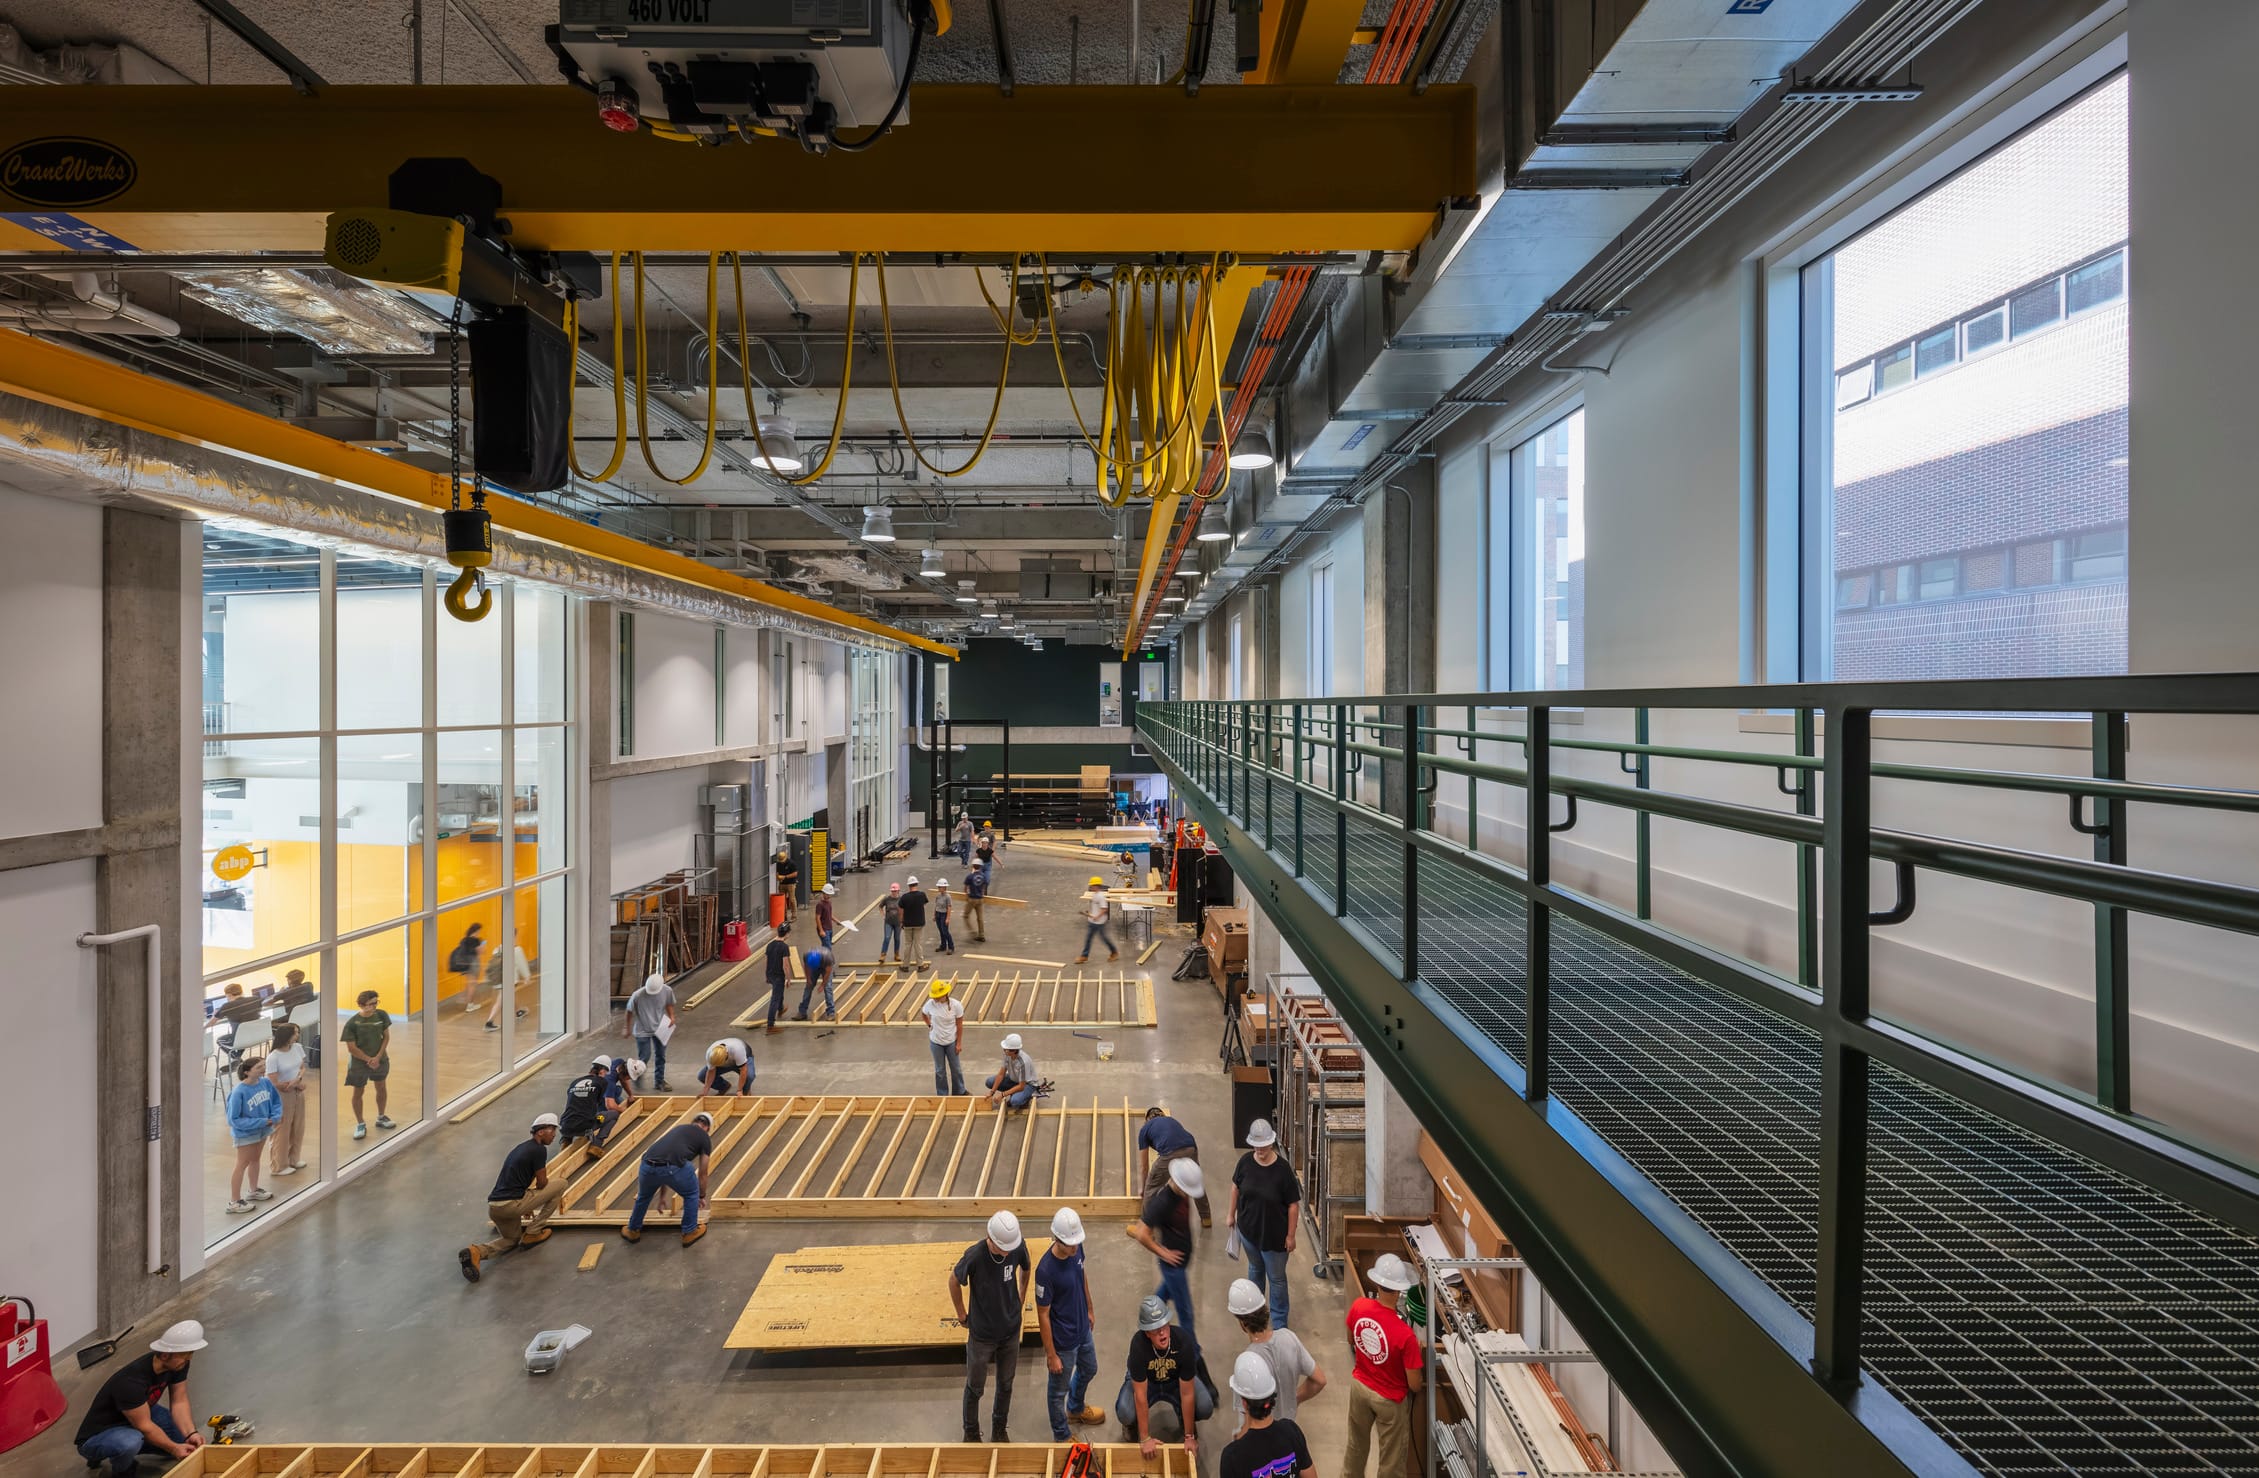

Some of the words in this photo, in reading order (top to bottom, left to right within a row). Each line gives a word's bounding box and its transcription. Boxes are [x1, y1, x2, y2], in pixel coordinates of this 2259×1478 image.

[628, 0, 662, 22] 460
[668, 0, 711, 22] VOLT
[4, 155, 125, 186] CraneWerks
[219, 856, 249, 870] abp
[1360, 1321, 1383, 1338] POWER
